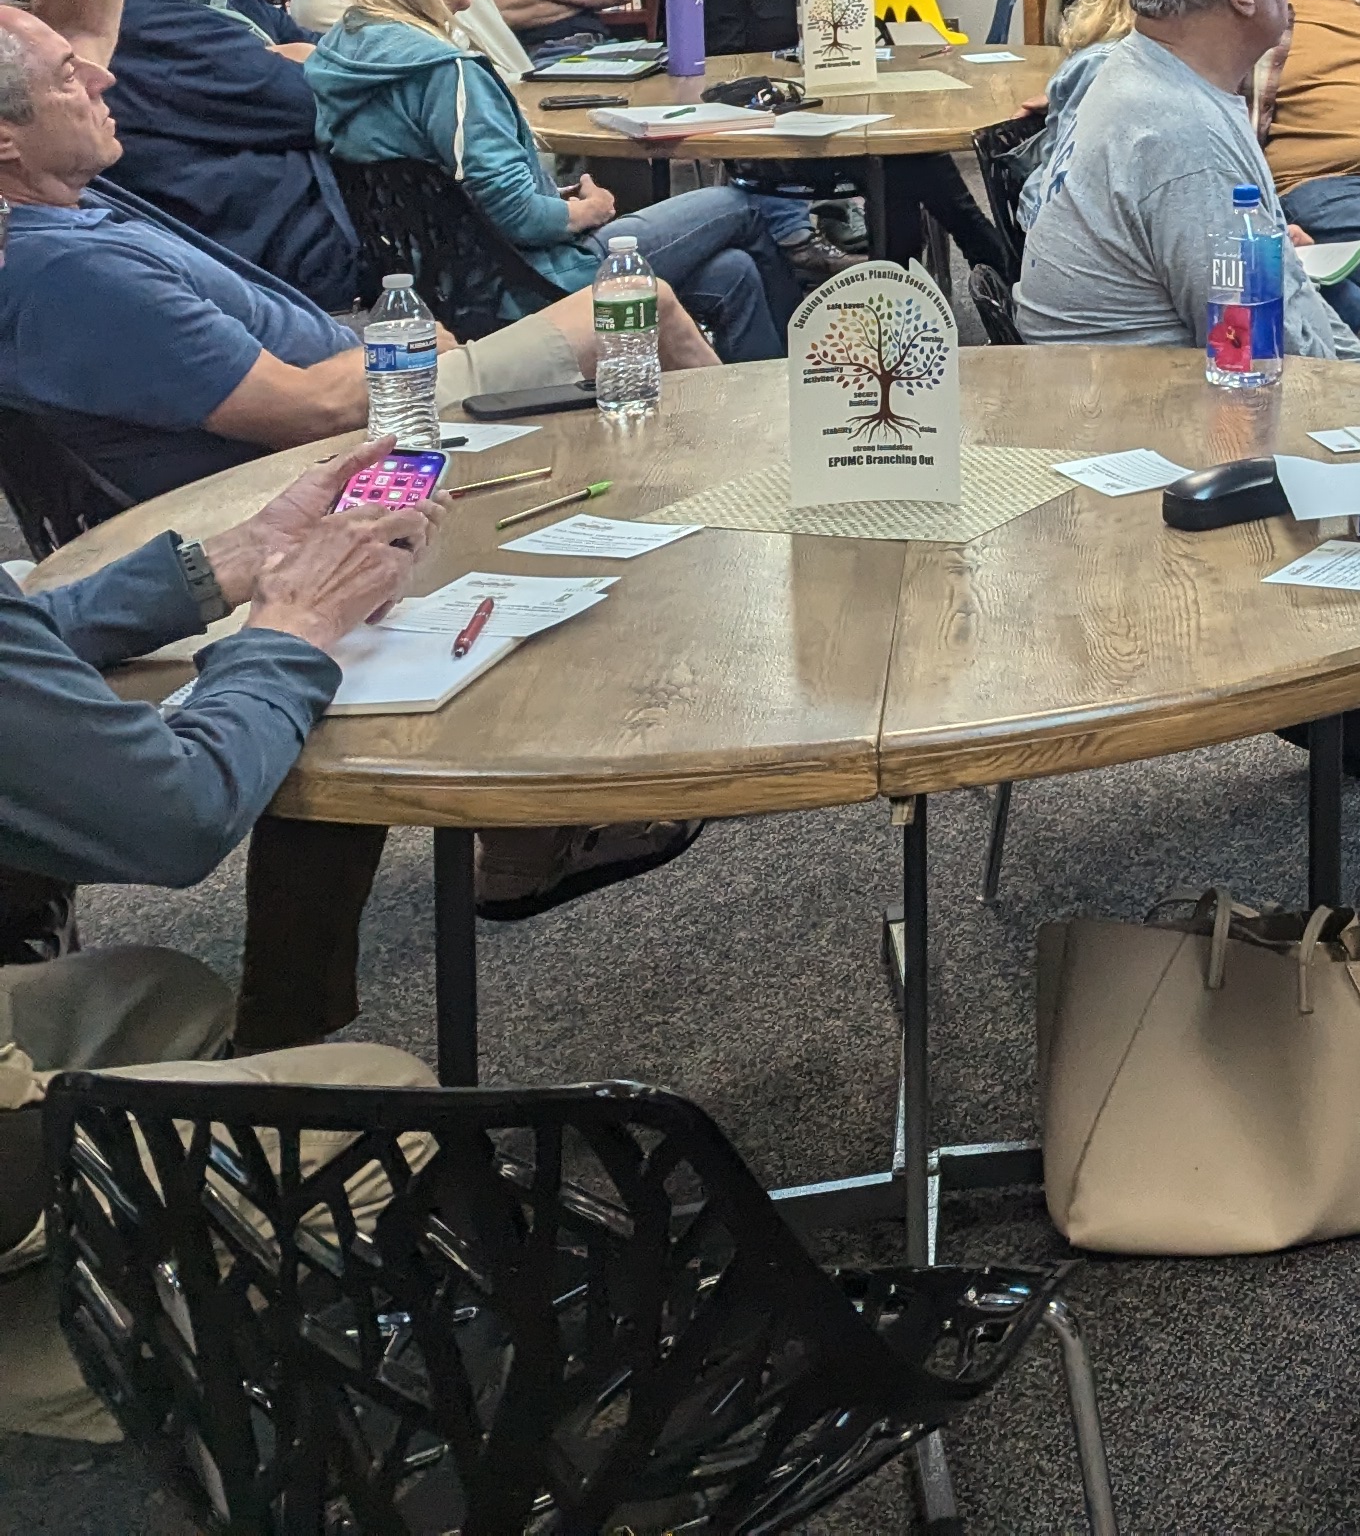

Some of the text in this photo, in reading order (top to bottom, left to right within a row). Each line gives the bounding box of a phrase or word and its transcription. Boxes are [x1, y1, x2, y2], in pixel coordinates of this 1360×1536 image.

[1212, 259, 1244, 287] FIJI
[819, 284, 835, 298] Our
[869, 269, 904, 283] Planting
[904, 274, 928, 293] Seeds
[927, 289, 935, 298] of
[934, 296, 954, 330] Renewal
[853, 444, 875, 452] strong
[828, 454, 935, 467] EPUMC Branching Out
